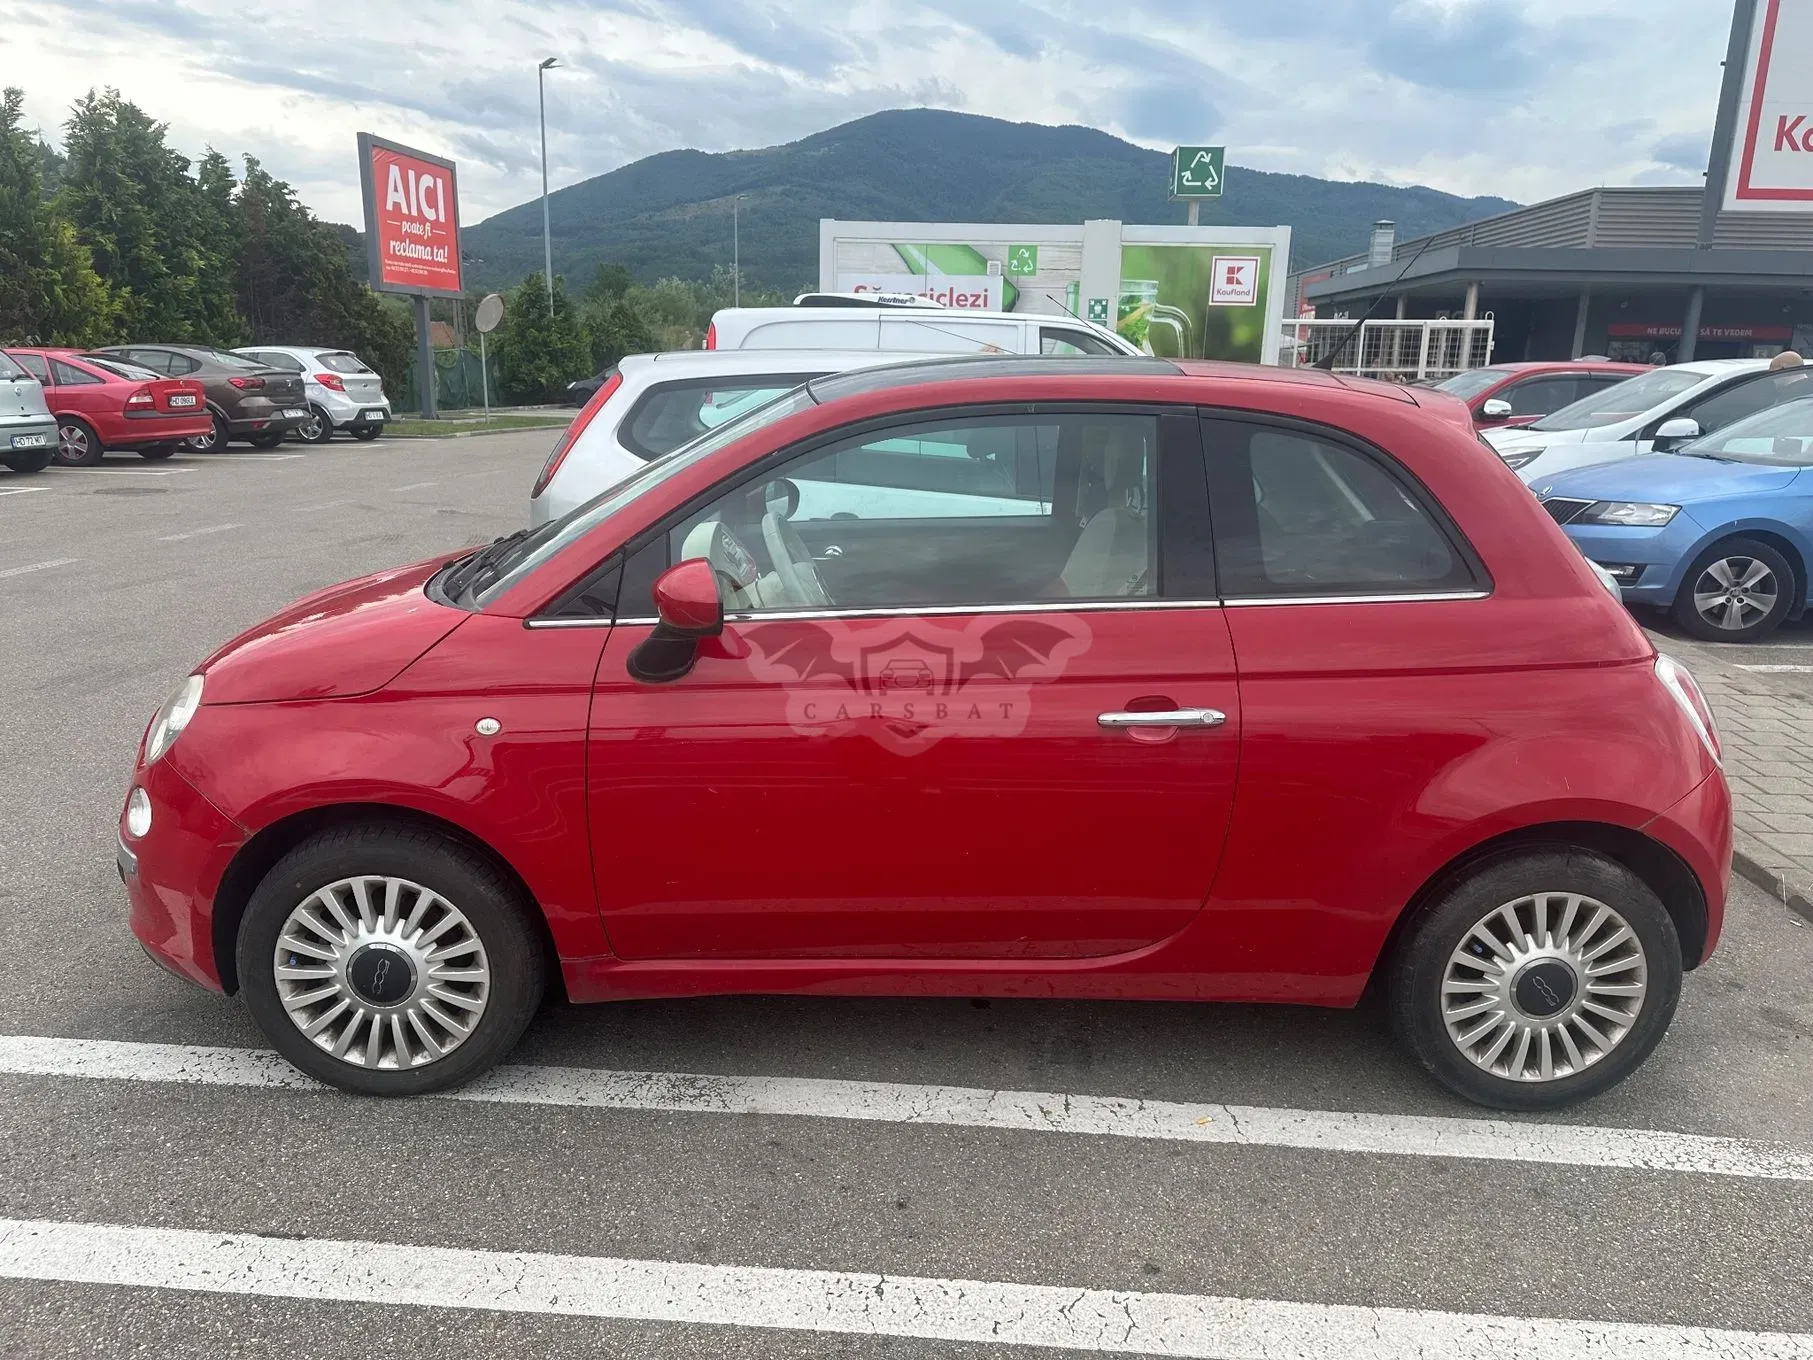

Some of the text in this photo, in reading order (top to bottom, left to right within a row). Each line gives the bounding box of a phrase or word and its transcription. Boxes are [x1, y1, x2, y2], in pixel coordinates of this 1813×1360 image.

[386, 164, 446, 223] AICI
[402, 221, 431, 239] poate fi
[390, 238, 448, 263] reclama ta!
